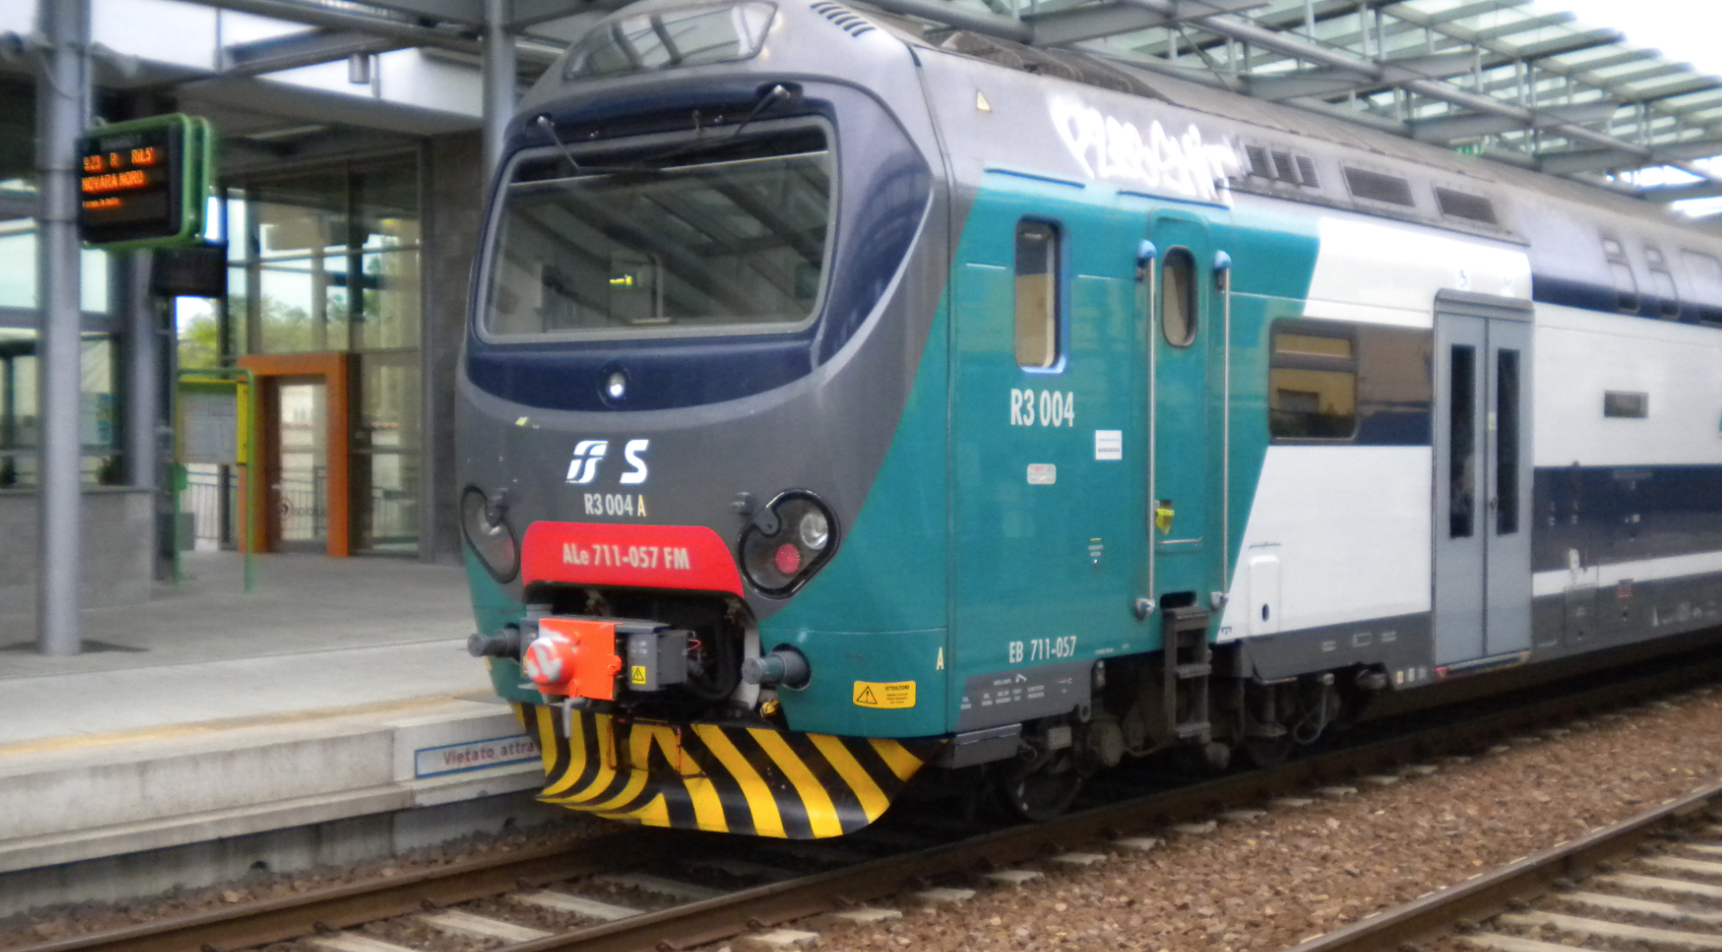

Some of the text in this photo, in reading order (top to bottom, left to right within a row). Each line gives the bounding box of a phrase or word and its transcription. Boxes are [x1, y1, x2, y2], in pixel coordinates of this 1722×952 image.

[1010, 388, 1075, 428] R3 004
[583, 493, 646, 517] R3 004 A
[562, 543, 690, 570] ALe 711-057 FM
[936, 647, 945, 670] A
[1009, 635, 1077, 663] EB 711-057
[442, 747, 495, 766] Vietato
